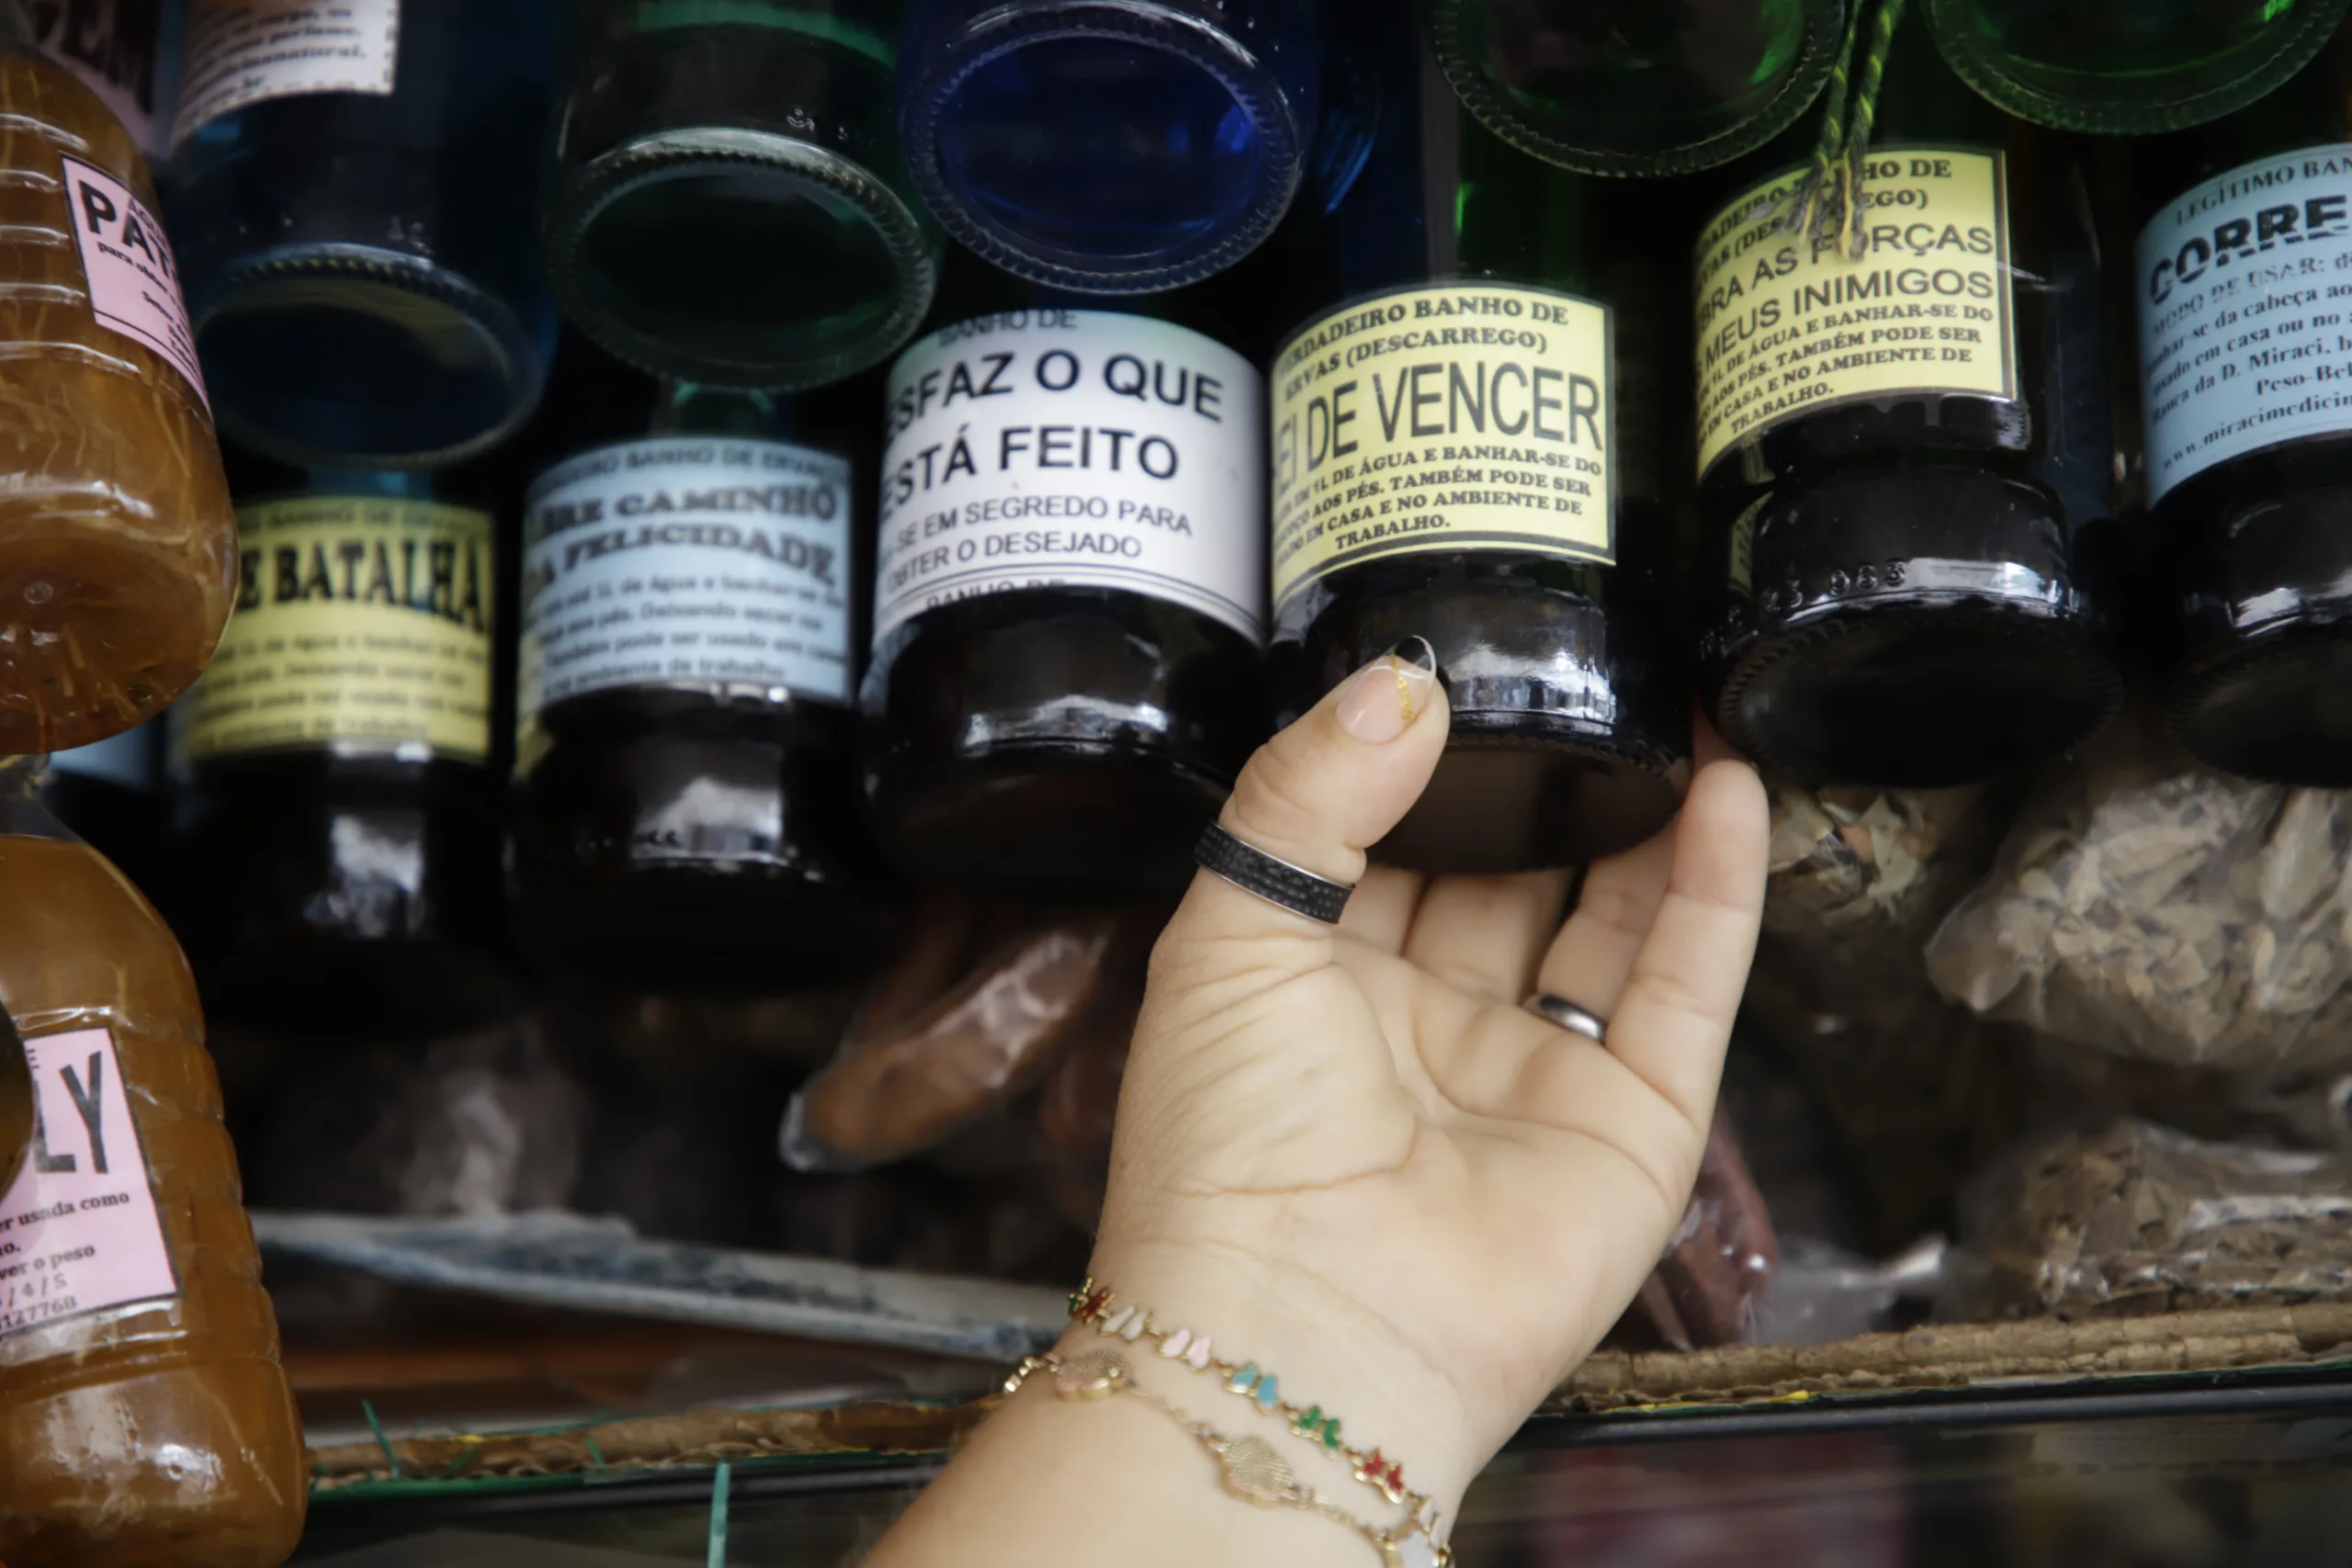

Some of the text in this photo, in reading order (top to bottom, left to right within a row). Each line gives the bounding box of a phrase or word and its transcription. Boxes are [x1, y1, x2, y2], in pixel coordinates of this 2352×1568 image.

[1910, 159, 1952, 179] DE
[96, 241, 134, 266] para
[1751, 246, 1799, 290] AS
[1811, 223, 1994, 265] FRÇAS
[1414, 296, 1524, 319] BANHO
[1532, 300, 1569, 325] DE
[1705, 267, 1994, 371] MEUS INIMIGOS
[2215, 310, 2239, 330] da
[2243, 288, 2318, 318] cabeça
[1346, 327, 1548, 368] (DESCARREGO)
[1726, 351, 1747, 373] DE
[1748, 326, 1802, 360] ÁGUA
[1806, 319, 1819, 334] E
[1824, 303, 1959, 329] BANHAR-SE
[1963, 305, 1995, 321] DO
[2195, 344, 2222, 367] em
[2226, 326, 2271, 353] casa
[2278, 318, 2304, 336] ou
[2311, 312, 2342, 329] no
[1035, 348, 1082, 392] O
[1102, 353, 1224, 423] QUE
[1712, 384, 1736, 410] AOS
[1738, 360, 1773, 388] PÉS.
[1775, 331, 1866, 367] TAMBÉM
[1871, 326, 1934, 344] PODE
[1939, 326, 1983, 344] SER
[1724, 385, 1765, 420] CASA
[1768, 377, 1780, 393] E
[1782, 366, 1812, 387] NO
[1815, 347, 1937, 377] AMBIENTE
[1940, 346, 1973, 362] DE
[2194, 374, 2217, 395] da
[1306, 379, 1359, 474] DE
[1372, 361, 1604, 451] VENCER
[1730, 381, 1834, 435] TRABALHO.
[998, 425, 1179, 480] FEITO
[1332, 465, 1356, 486] DE
[1359, 455, 1419, 477] ÁGUA
[1424, 447, 1438, 463] E
[1442, 446, 1570, 468] BANHAR-SE
[1576, 457, 1602, 477] DO
[1312, 493, 1342, 519] AOS
[1346, 481, 1385, 503] PÉS.
[1389, 465, 1484, 491] TAMBÉM
[1489, 469, 1548, 489] PODE
[1553, 476, 1592, 497] SER
[1327, 504, 1375, 532] CASA
[1380, 499, 1393, 515] E
[1396, 494, 1428, 512] NO
[1432, 491, 1550, 510] AMBIENTE
[1555, 497, 1583, 516] DE
[924, 508, 958, 538] EM
[965, 496, 1108, 526] SEGREDO
[1117, 500, 1193, 536] PARA
[1334, 514, 1451, 550] TRABALHO.
[956, 539, 978, 561] O
[985, 530, 1143, 558] DESEJADO
[18, 1201, 76, 1225] usada
[80, 1192, 130, 1211] como
[33, 1257, 45, 1270] o
[50, 1245, 96, 1269] peso
